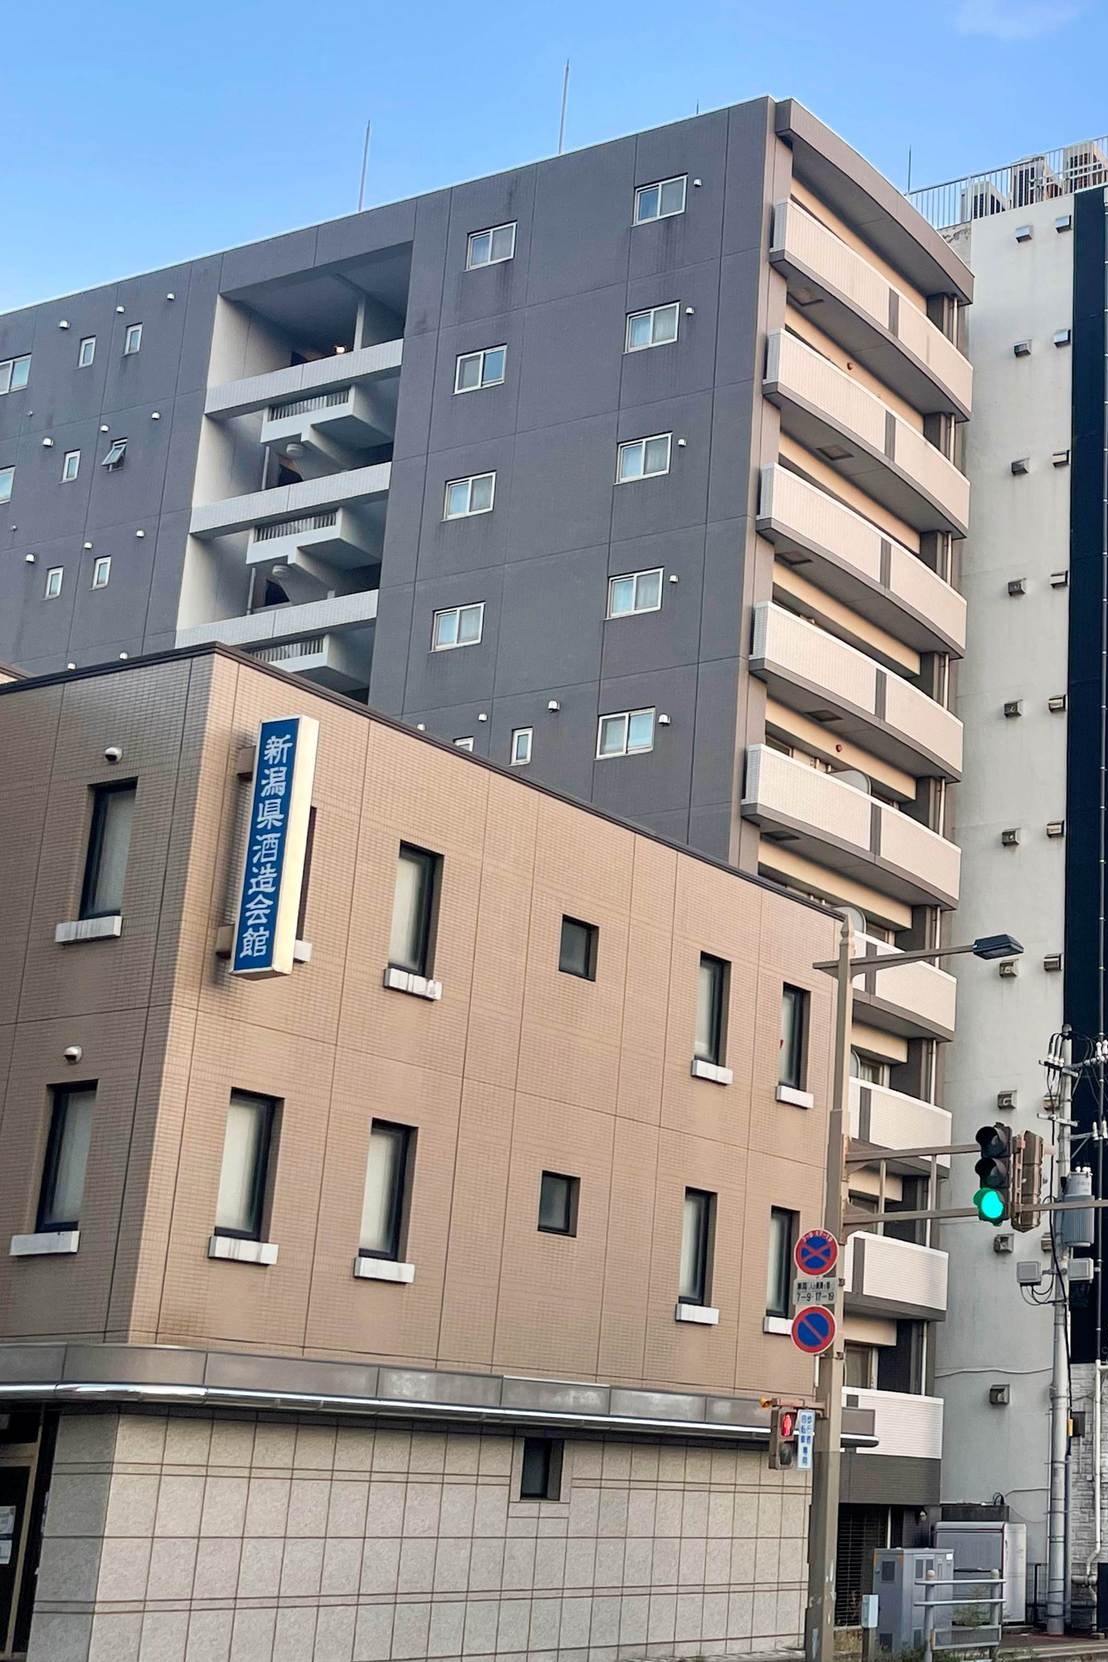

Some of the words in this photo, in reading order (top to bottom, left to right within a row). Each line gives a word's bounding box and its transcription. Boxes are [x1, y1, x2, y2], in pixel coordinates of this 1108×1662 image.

[239, 734, 293, 959] 新潟県酒造会館
